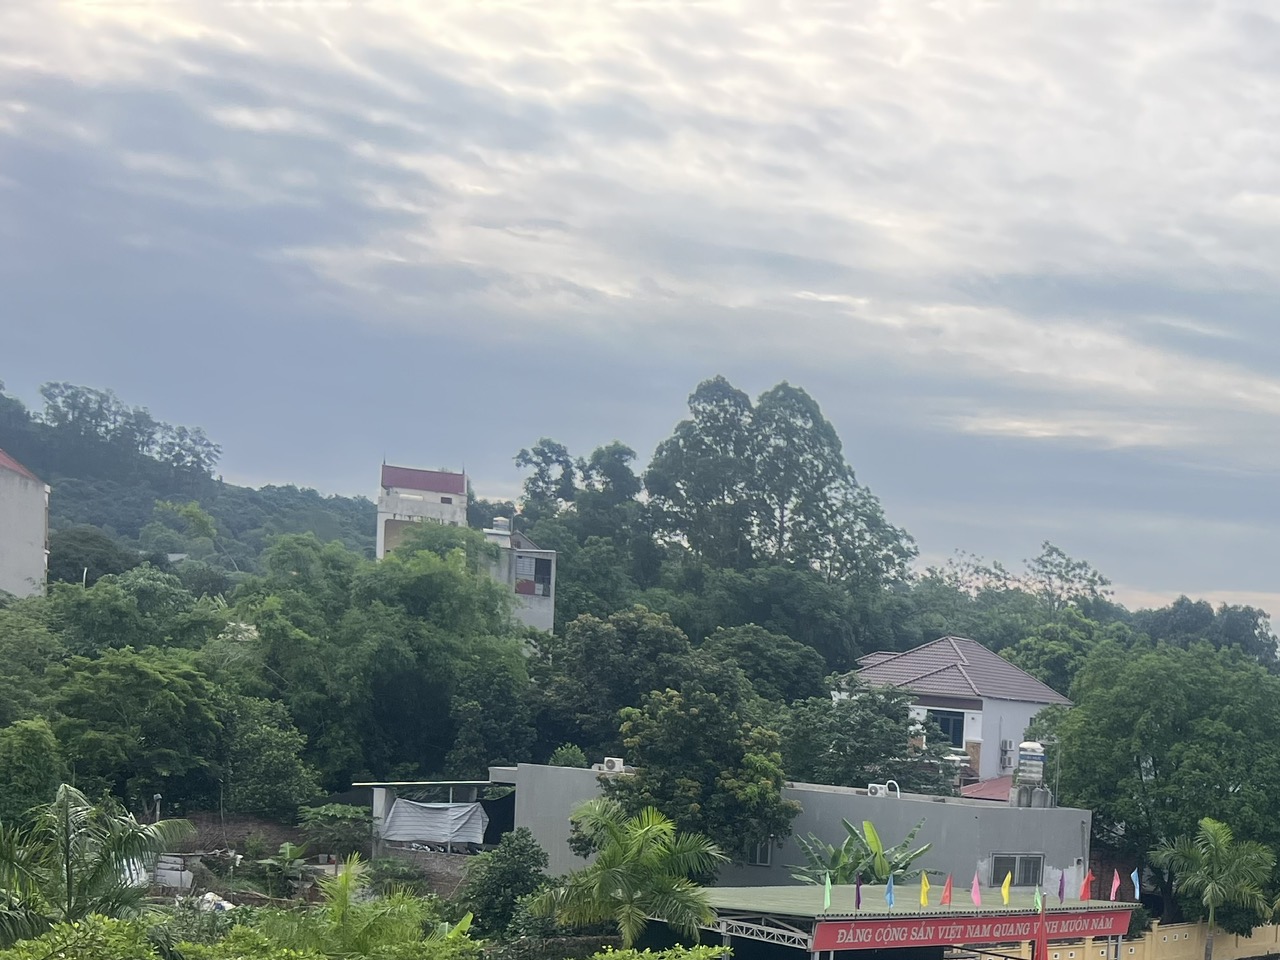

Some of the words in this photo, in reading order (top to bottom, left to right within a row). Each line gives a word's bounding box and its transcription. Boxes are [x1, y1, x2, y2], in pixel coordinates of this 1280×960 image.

[836, 923, 873, 943] ĐẢNG
[875, 924, 908, 944] CỘNG
[910, 921, 935, 940] SẢN
[938, 922, 964, 941] VIỆT
[965, 924, 992, 938] NAM
[993, 922, 1031, 938] QUANG
[1033, 921, 1058, 934] VNH
[1060, 915, 1089, 932] MUÔN
[1090, 916, 1113, 930] NĂM
